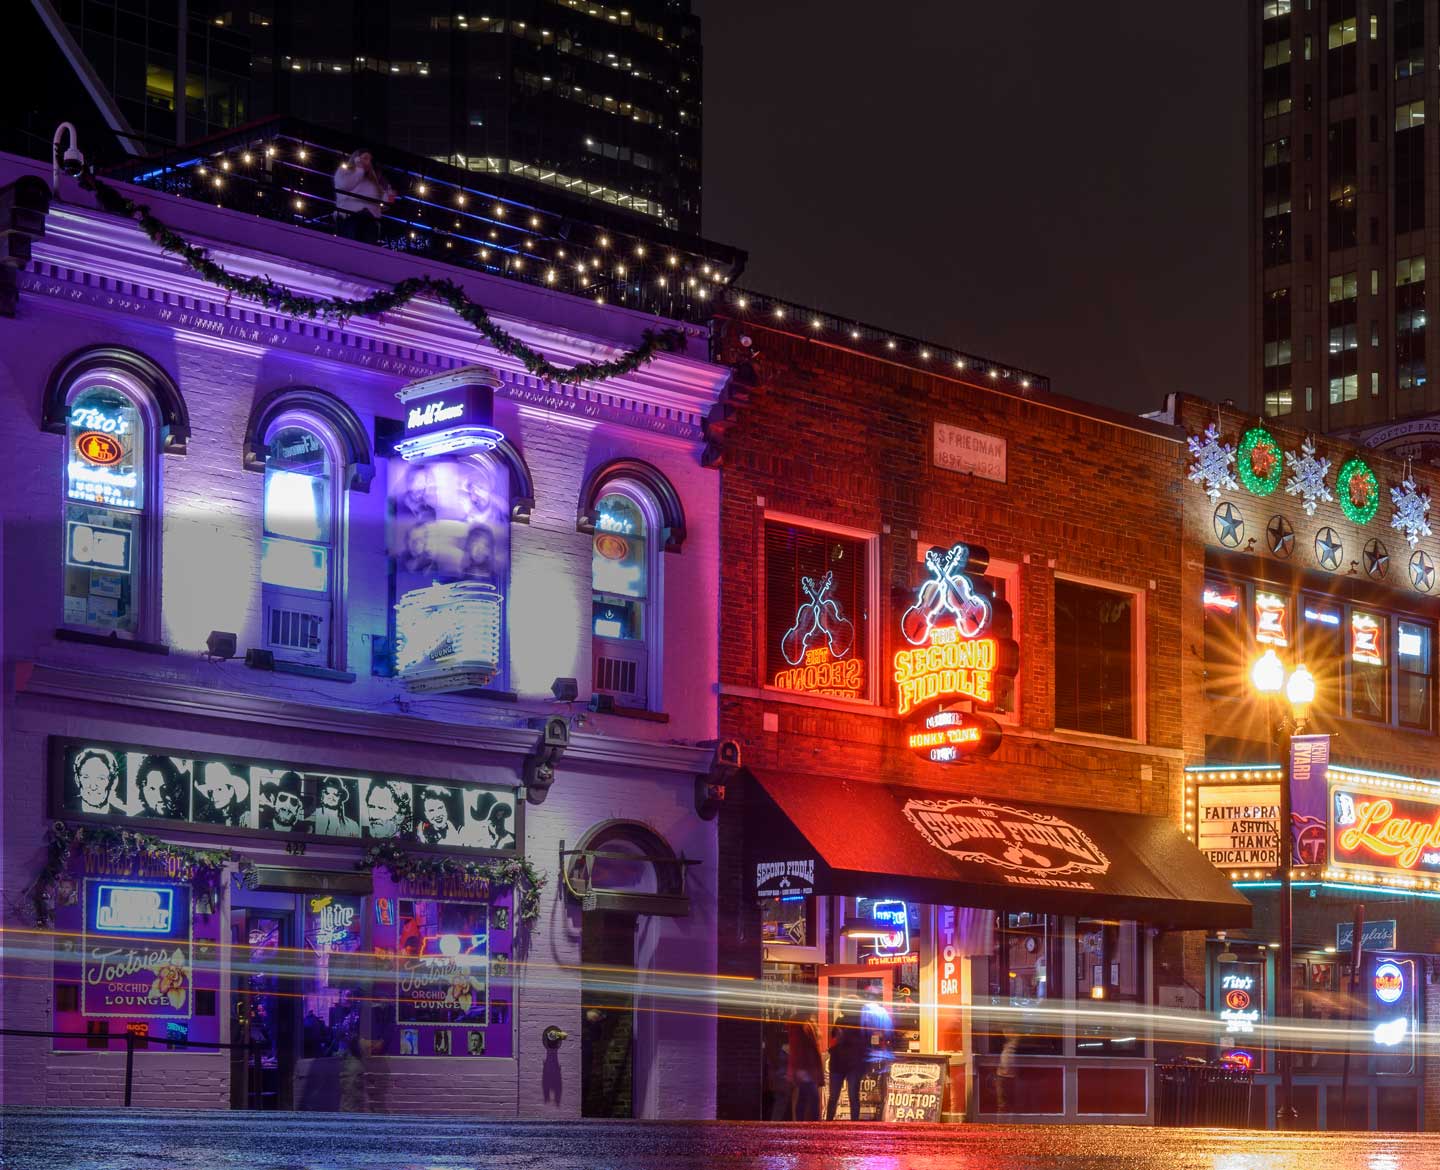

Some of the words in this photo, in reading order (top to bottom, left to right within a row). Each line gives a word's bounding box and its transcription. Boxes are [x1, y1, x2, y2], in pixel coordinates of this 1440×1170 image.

[71, 408, 129, 435] Tito's
[948, 431, 1002, 458] FRIEDMAN
[931, 626, 960, 645] THE
[894, 638, 999, 684] SECOND
[898, 668, 992, 715] FIDDLE
[909, 731, 945, 748] HONKY
[1311, 742, 1328, 764] KEVIN
[1293, 743, 1312, 780] BYARD
[978, 809, 999, 818] THE
[1205, 806, 1241, 819] FAITH
[1231, 821, 1280, 834] ASHVILL
[918, 811, 1006, 849] SECOND
[1000, 820, 1099, 864] FIDDLE
[756, 861, 785, 888] SECOND
[786, 859, 815, 885] FIDDLE
[1003, 875, 1096, 890] NASHVILLE
[1340, 928, 1393, 946] Lyla's
[87, 948, 172, 985] Tootsies
[880, 956, 902, 965] MILLER
[902, 954, 918, 964] TIME
[107, 983, 150, 994] ORCHID
[941, 979, 958, 995] BAR
[1222, 975, 1253, 990] Tito's
[105, 996, 170, 1006] LOUNGE
[411, 990, 446, 1000] ORCHID
[413, 1000, 461, 1010] LOUNGE
[888, 1092, 937, 1108] ROOFTOP
[896, 1107, 925, 1120] BAR
